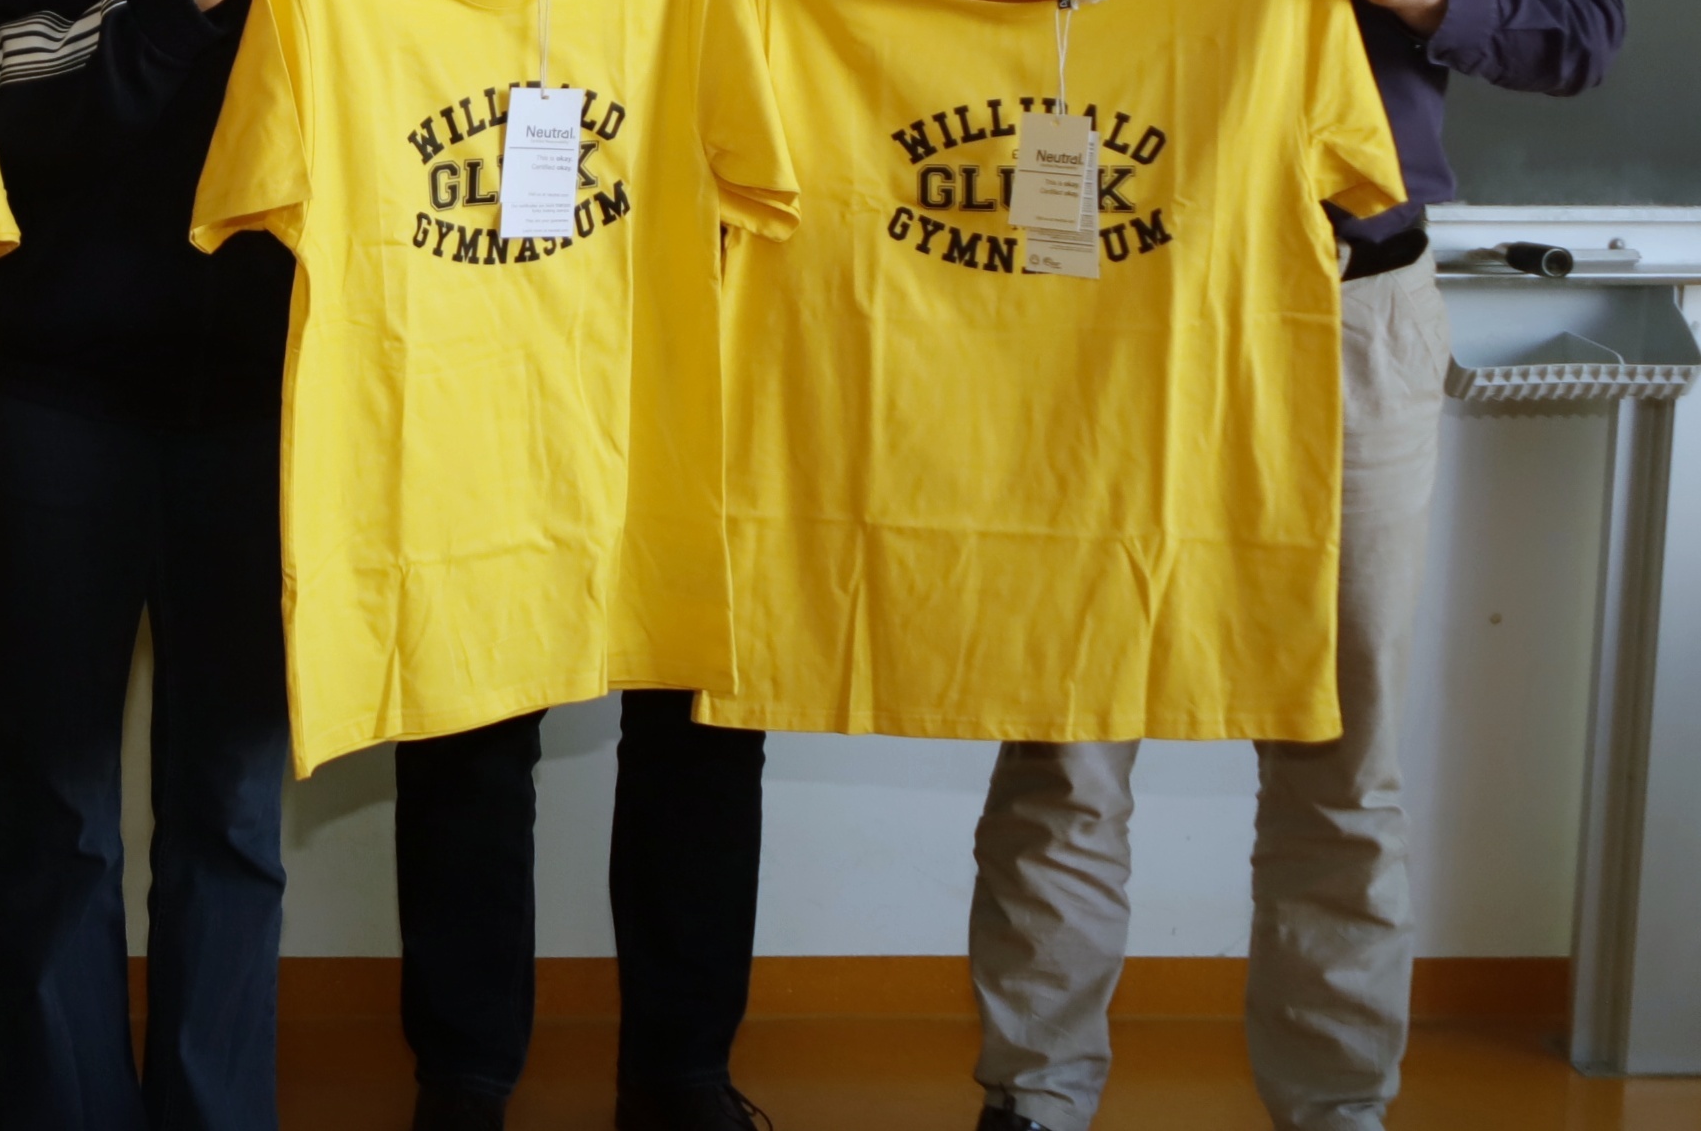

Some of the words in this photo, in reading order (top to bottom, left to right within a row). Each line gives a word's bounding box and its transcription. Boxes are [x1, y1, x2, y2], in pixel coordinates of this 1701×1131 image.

[407, 80, 626, 165] WILLLD
[891, 97, 1167, 166] WILLLD
[428, 140, 599, 212] GLK
[917, 164, 1136, 213] GLK
[887, 208, 1173, 274] GYMNUM
